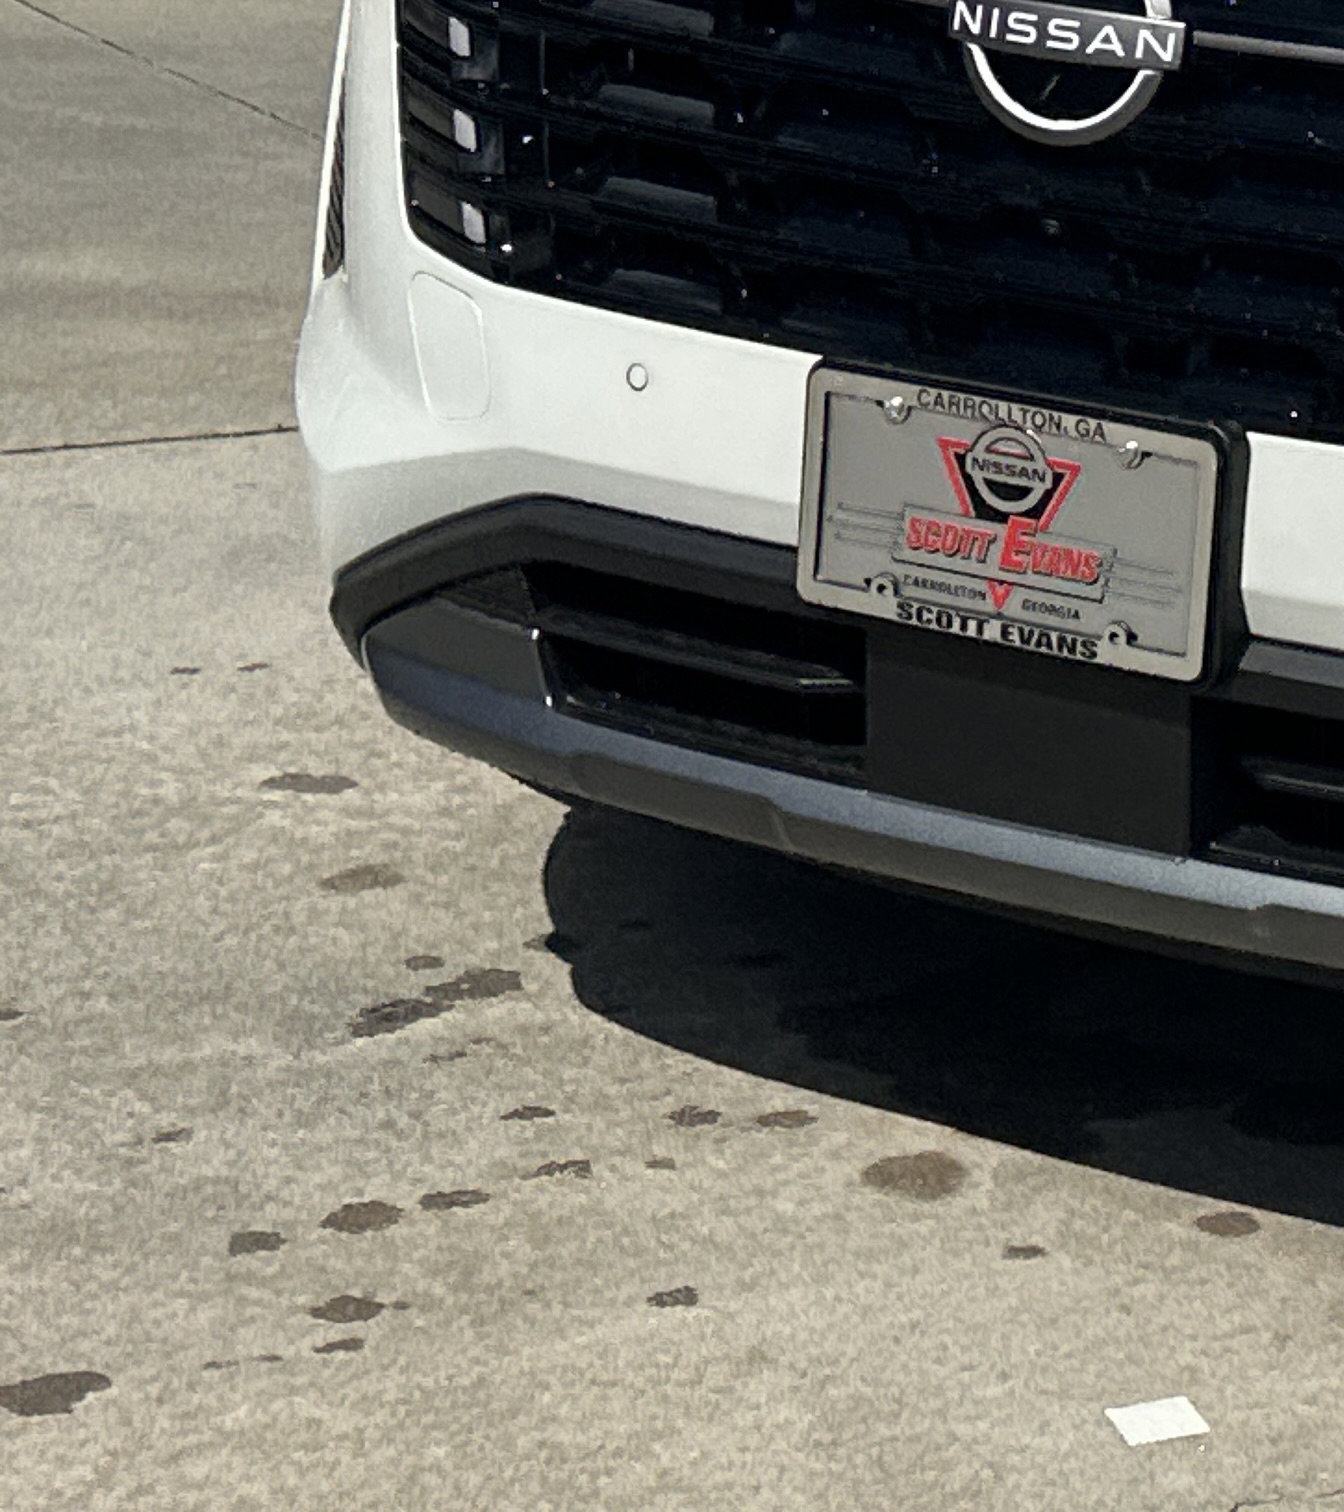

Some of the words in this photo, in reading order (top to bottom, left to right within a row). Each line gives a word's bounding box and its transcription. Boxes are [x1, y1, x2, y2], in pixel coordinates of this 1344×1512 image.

[953, 0, 1176, 62] NISSAN
[1074, 417, 1109, 443] GA
[970, 456, 1048, 485] NISSAN
[905, 515, 998, 563] SCOTT
[999, 514, 1106, 584] EVANS
[895, 600, 990, 638] SCOTT
[999, 623, 1099, 660] EVANS
[1021, 597, 1082, 621] GEORGIA
